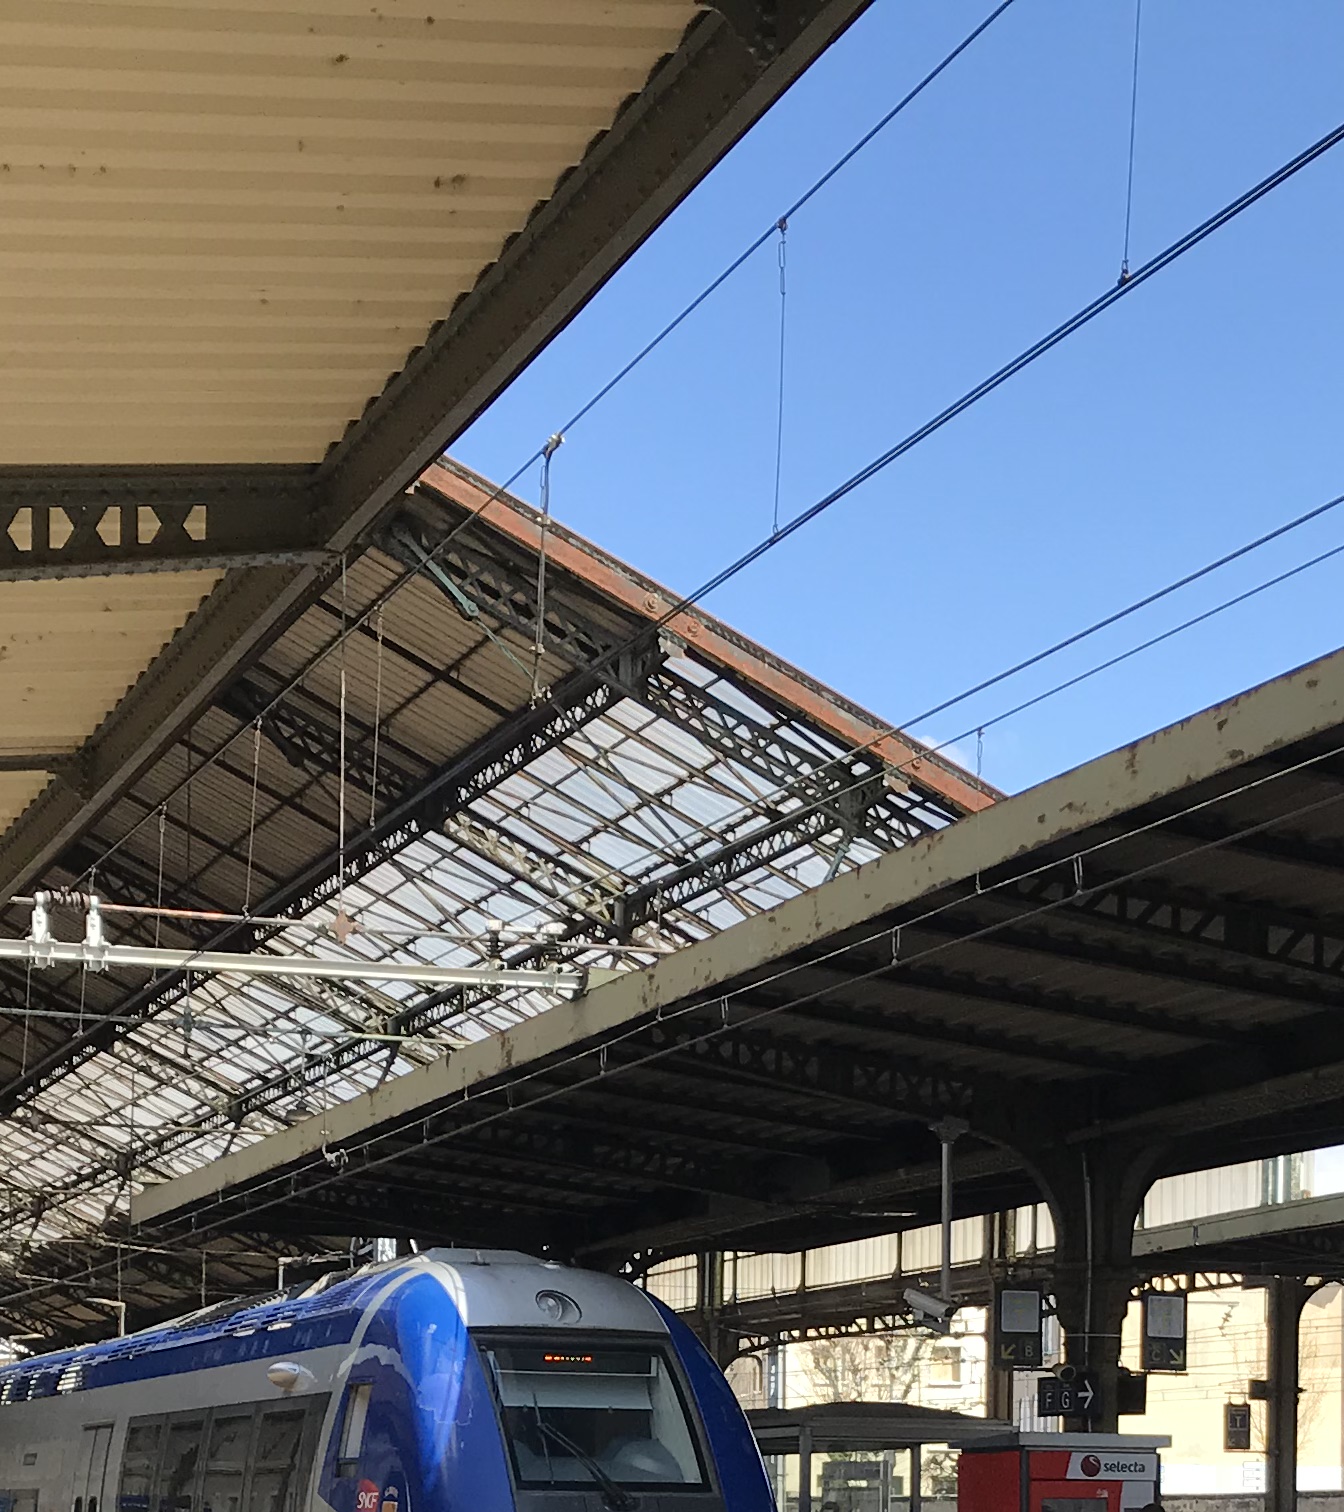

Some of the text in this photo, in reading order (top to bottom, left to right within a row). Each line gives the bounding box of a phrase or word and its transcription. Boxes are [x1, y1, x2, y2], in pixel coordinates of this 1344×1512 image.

[1025, 1345, 1034, 1358] B
[1151, 1350, 1161, 1361] C
[1046, 1391, 1070, 1409] F G
[1103, 1461, 1145, 1473] selecta
[357, 1492, 379, 1509] SNCF
